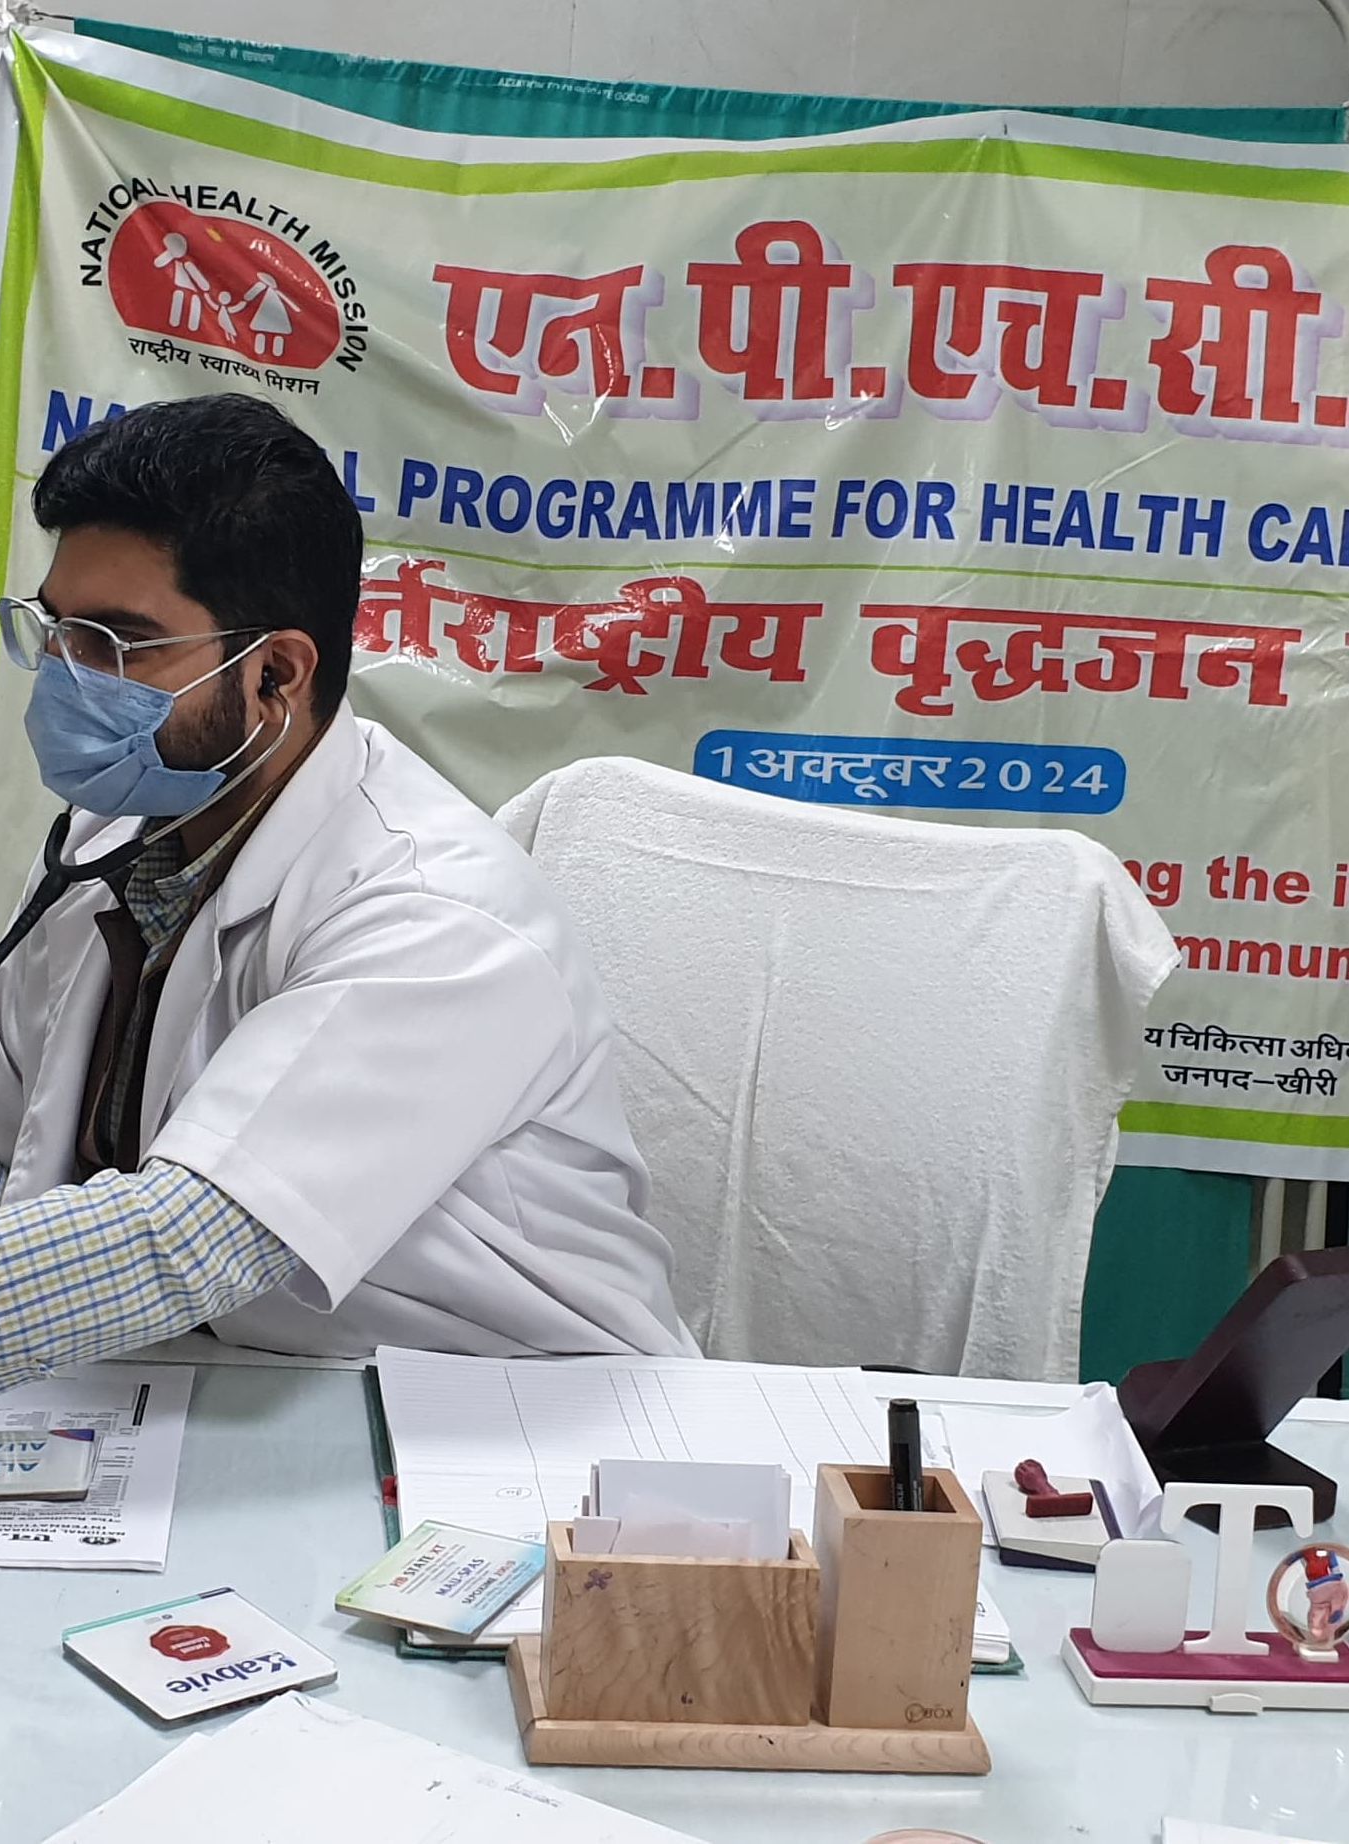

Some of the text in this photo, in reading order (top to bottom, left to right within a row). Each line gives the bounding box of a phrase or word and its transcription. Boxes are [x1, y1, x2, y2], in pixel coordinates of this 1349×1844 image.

[80, 177, 369, 372] NATIOAL HEALTH MISSION
[128, 337, 191, 365] राष्ट्रीय
[266, 369, 320, 395] मिशन
[397, 458, 816, 540] PROGRAMME
[831, 479, 955, 540] FOR
[980, 483, 1226, 558] HEALTH
[354, 559, 1302, 717] र्तराष्ट्रीय वृद्धजन
[1206, 856, 1310, 904] the
[1167, 1022, 1286, 1058] चिकित्सा
[1290, 1033, 1349, 1061] अधि
[159, 1651, 301, 1698] Kabvie
